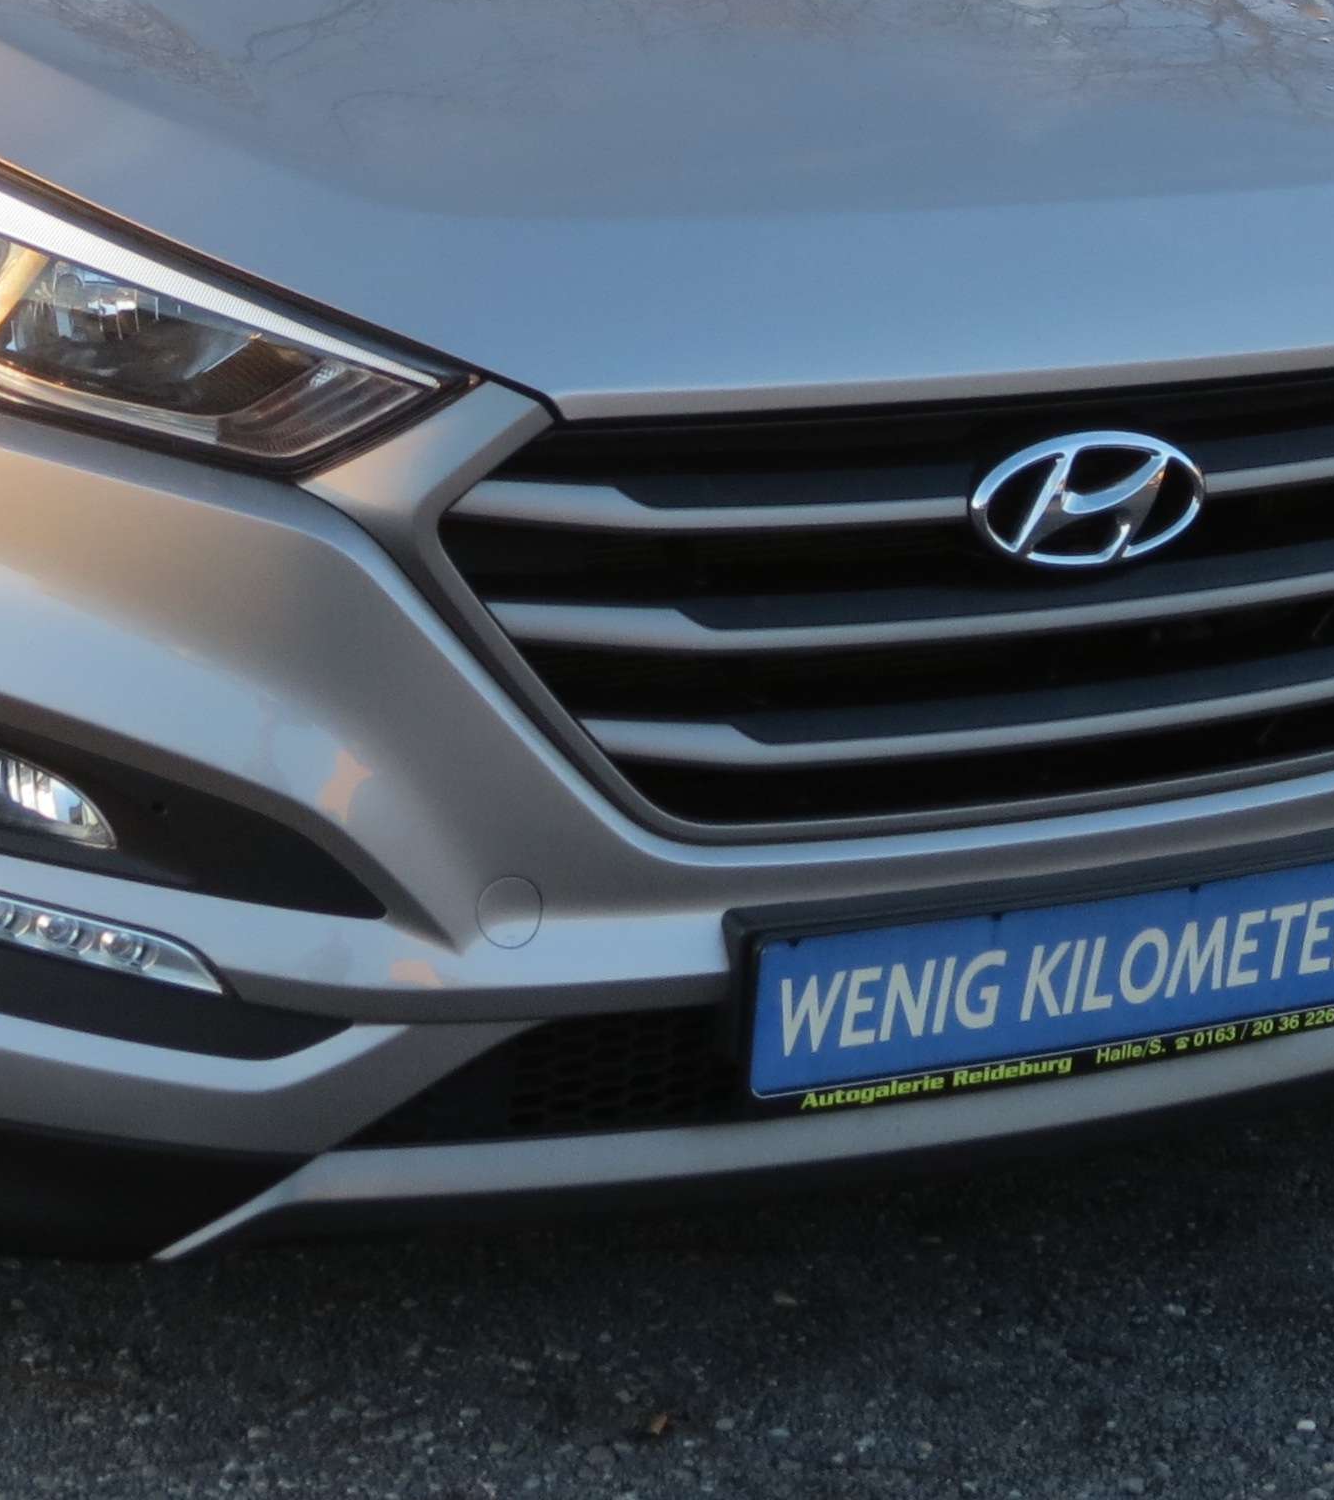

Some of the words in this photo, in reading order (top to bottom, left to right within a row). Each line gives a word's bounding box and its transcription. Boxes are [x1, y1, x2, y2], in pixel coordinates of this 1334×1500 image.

[780, 950, 1007, 1057] WENIG
[800, 1074, 945, 1110] Autogalerie
[952, 1056, 1073, 1087] Reideburg
[1096, 1038, 1167, 1065] Halle/S.
[1193, 1026, 1235, 1047] 0163
[1251, 1020, 1273, 1037] 20
[1277, 1015, 1299, 1032] 36
